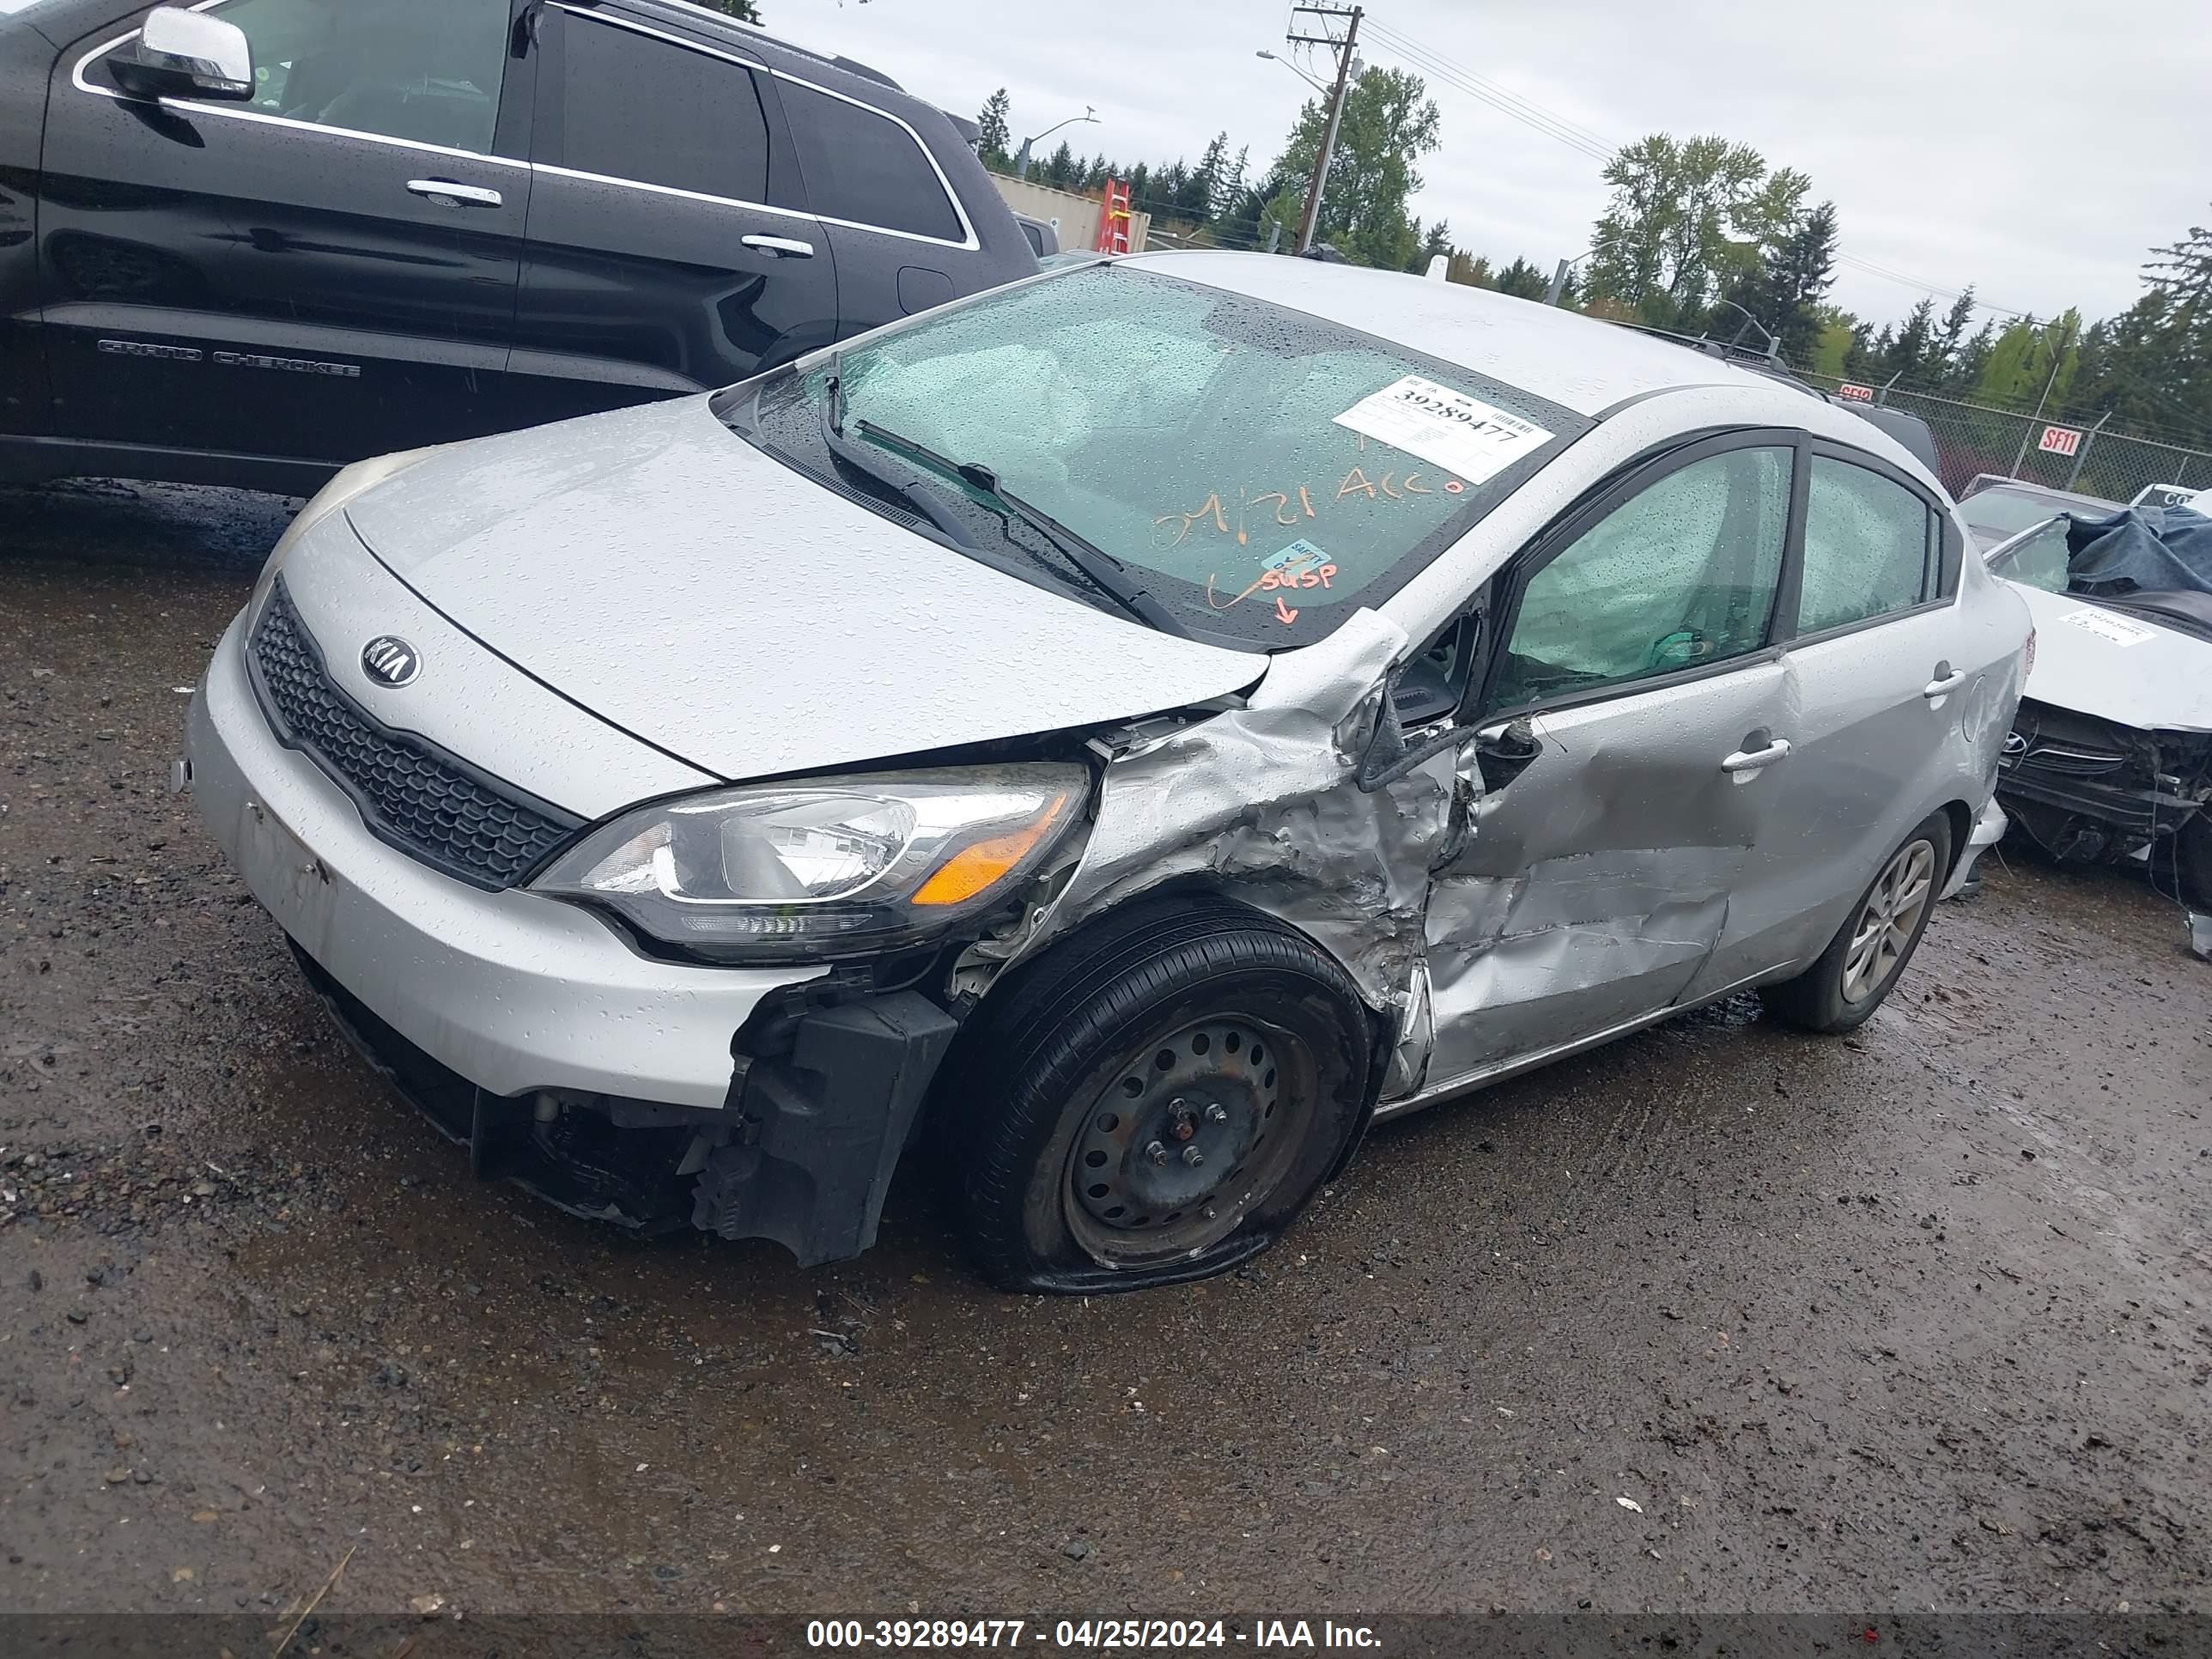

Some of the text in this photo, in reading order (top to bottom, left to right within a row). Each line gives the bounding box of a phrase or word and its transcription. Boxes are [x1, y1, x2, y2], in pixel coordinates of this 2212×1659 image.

[98, 339, 361, 377] GRAND CHEROKEE
[1395, 390, 1519, 442] 39289477
[2044, 429, 2076, 452] SF11
[363, 637, 410, 681] KIA
